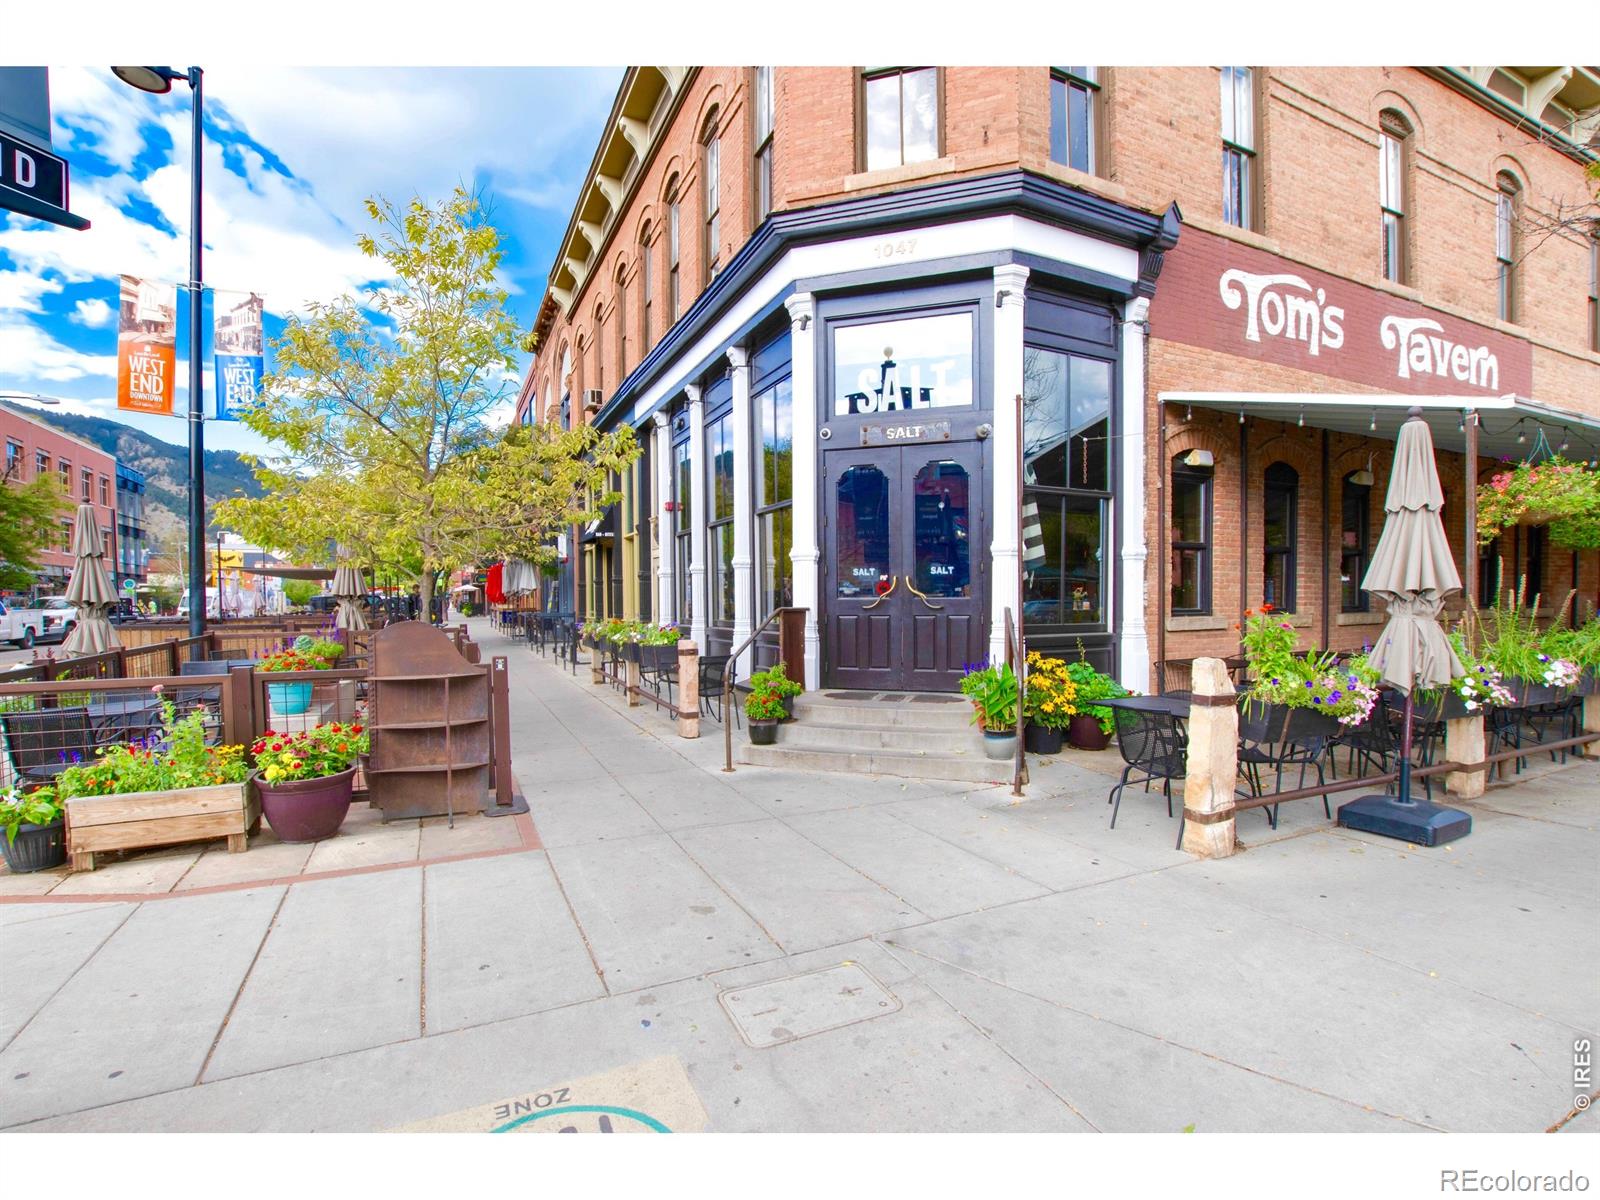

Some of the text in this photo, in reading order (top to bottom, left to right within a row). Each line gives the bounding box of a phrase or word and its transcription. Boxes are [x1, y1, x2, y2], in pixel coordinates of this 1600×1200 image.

[874, 238, 919, 259] 1047
[1218, 268, 1499, 390] Tom's Tavern
[128, 355, 166, 376] WEST
[130, 372, 164, 395] END
[223, 367, 255, 385] WEST
[130, 391, 163, 403] DOWNTOWN
[226, 384, 255, 403] END
[857, 359, 957, 415] SALT
[886, 425, 922, 439] SALT
[852, 567, 876, 576] SALT
[930, 566, 955, 575] SALT
[494, 1087, 571, 1120] ZONE
